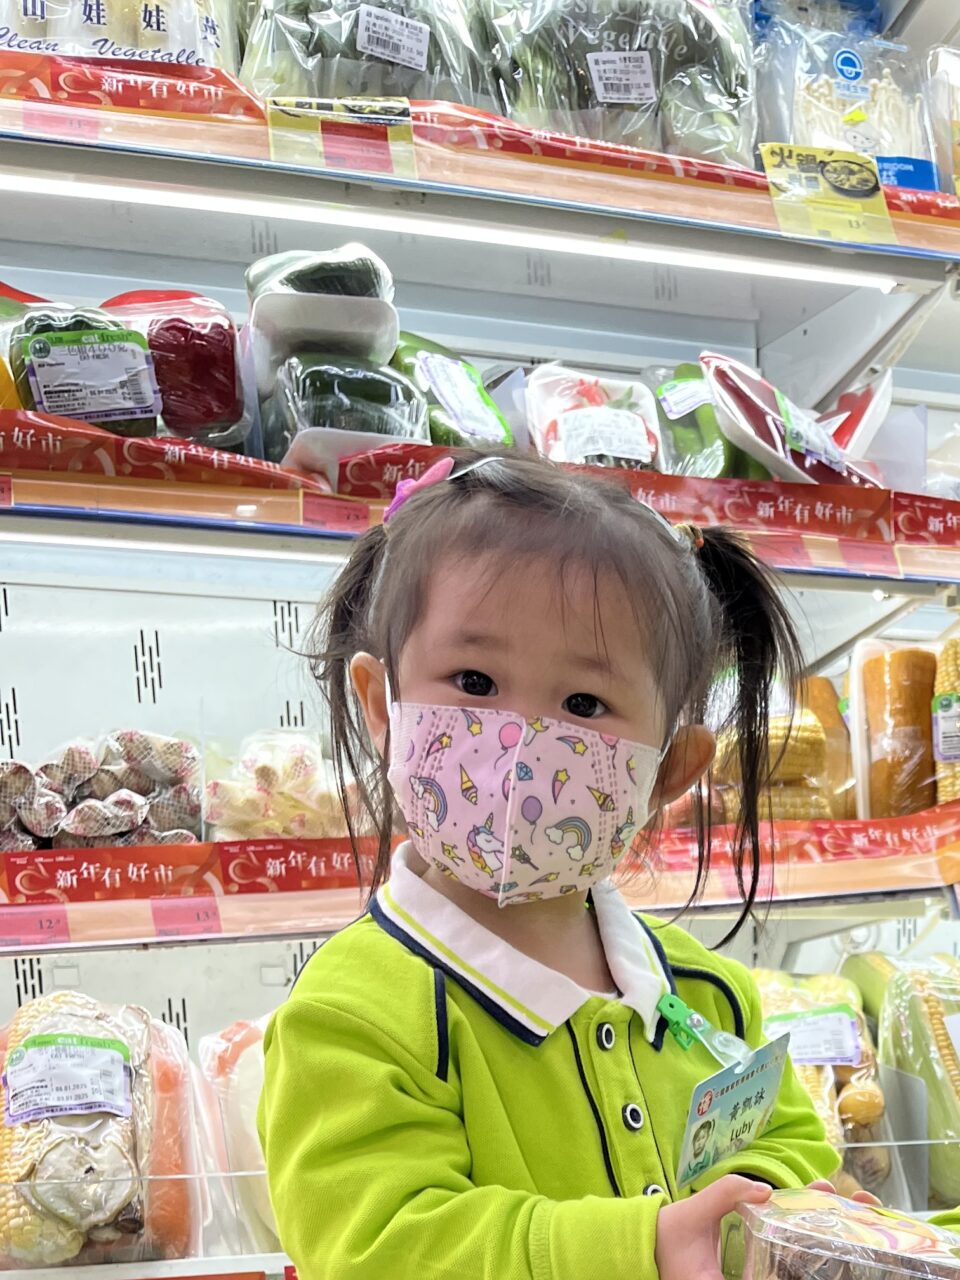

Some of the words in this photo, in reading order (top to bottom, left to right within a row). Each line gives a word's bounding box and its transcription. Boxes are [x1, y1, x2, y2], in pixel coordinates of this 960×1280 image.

[0, 27, 59, 51] Clean
[0, 427, 62, 454] 好市
[756, 496, 854, 524] 新年有好市
[55, 861, 174, 890] 新年有好市
